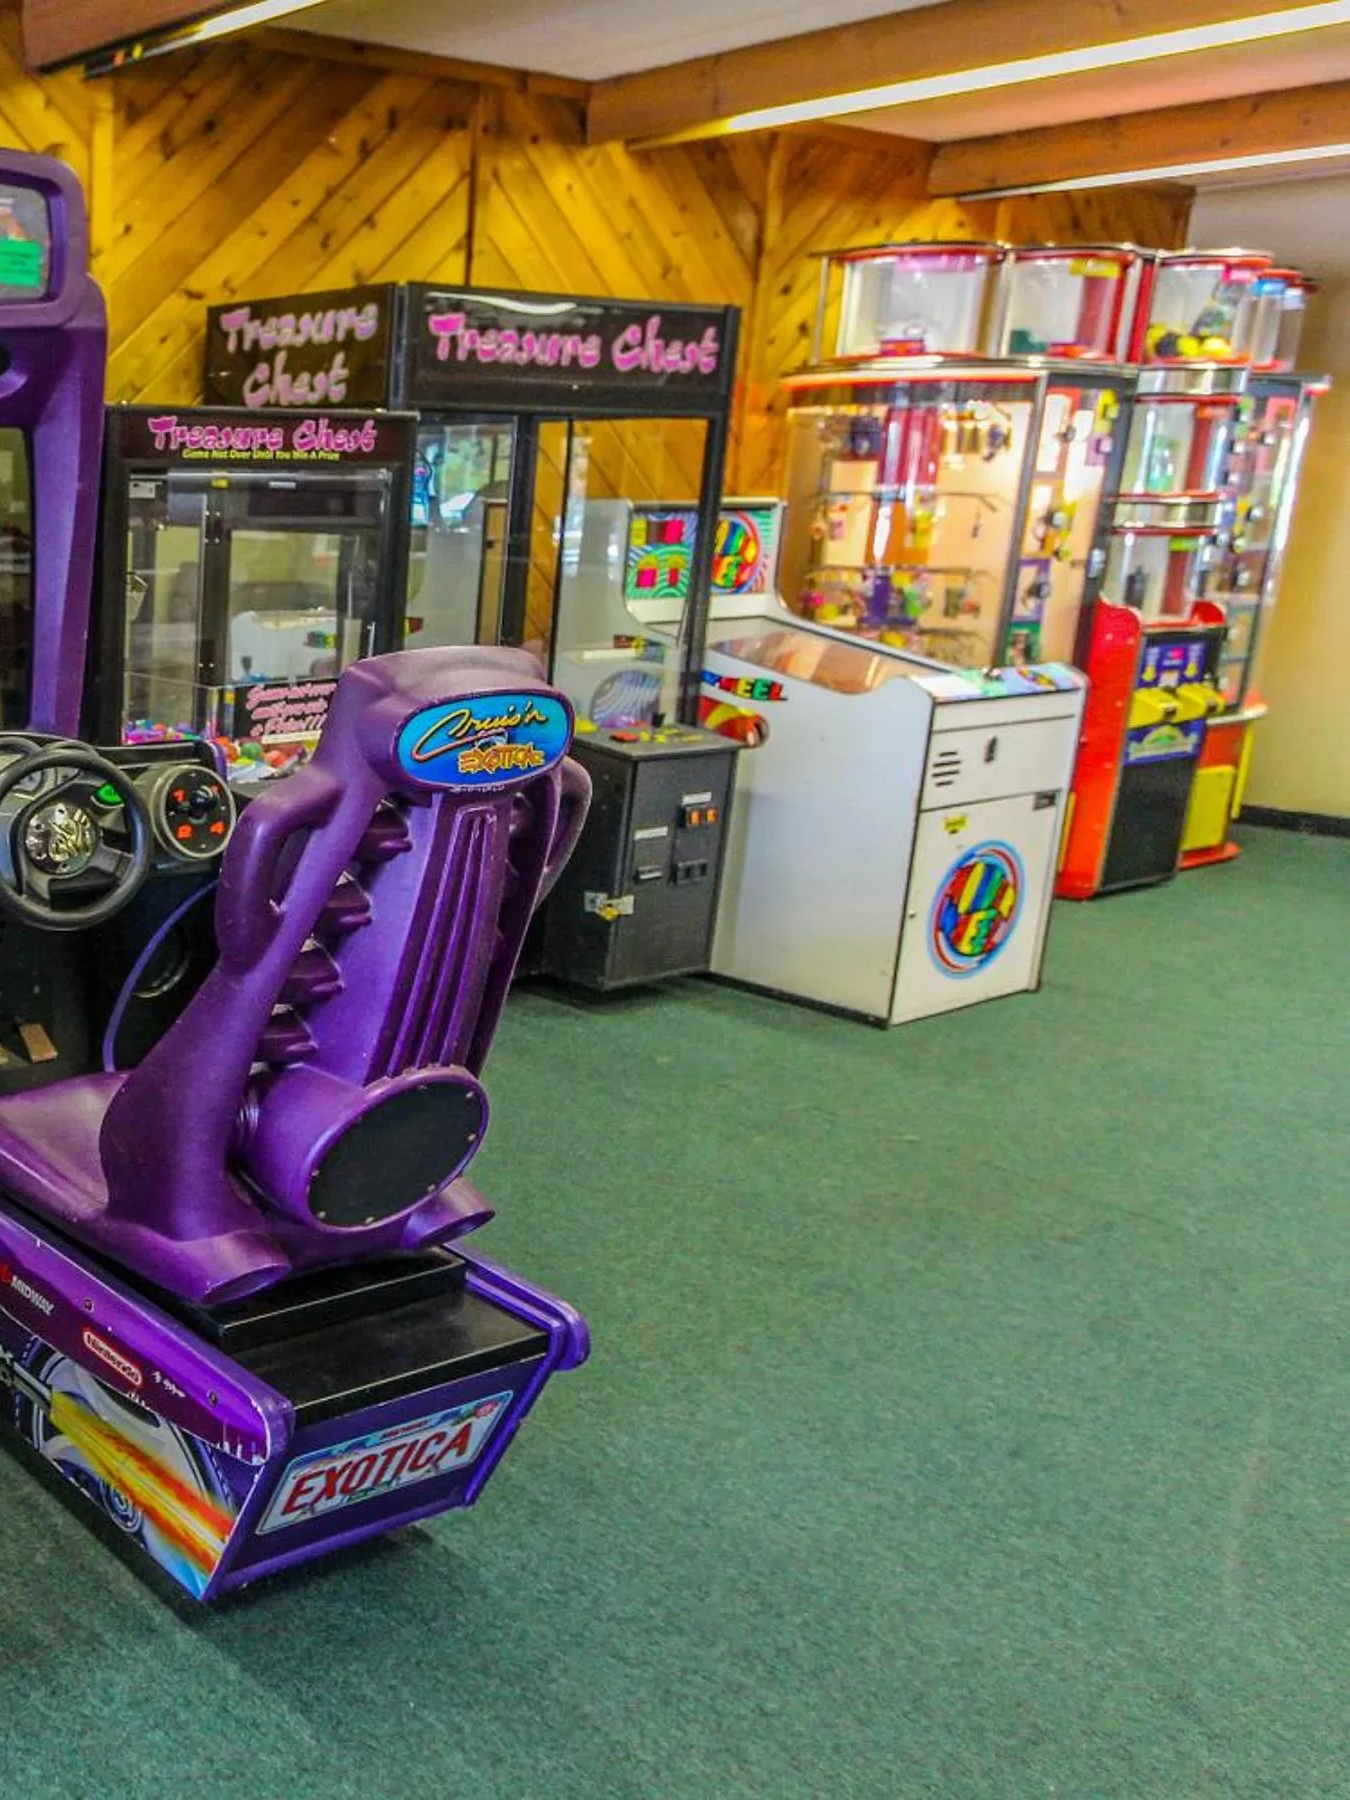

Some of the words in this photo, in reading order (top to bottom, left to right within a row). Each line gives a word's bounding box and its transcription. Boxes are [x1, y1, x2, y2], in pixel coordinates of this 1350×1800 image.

[220, 303, 379, 353] Treasure
[428, 311, 602, 368] Treasure
[612, 315, 720, 375] Chest
[243, 351, 350, 408] Chest
[147, 415, 284, 450] Treasure
[293, 418, 379, 452] Chest
[411, 700, 547, 762] Cruis'n
[458, 742, 546, 776] EXOTICA
[280, 1423, 474, 1517] EXOTICA
